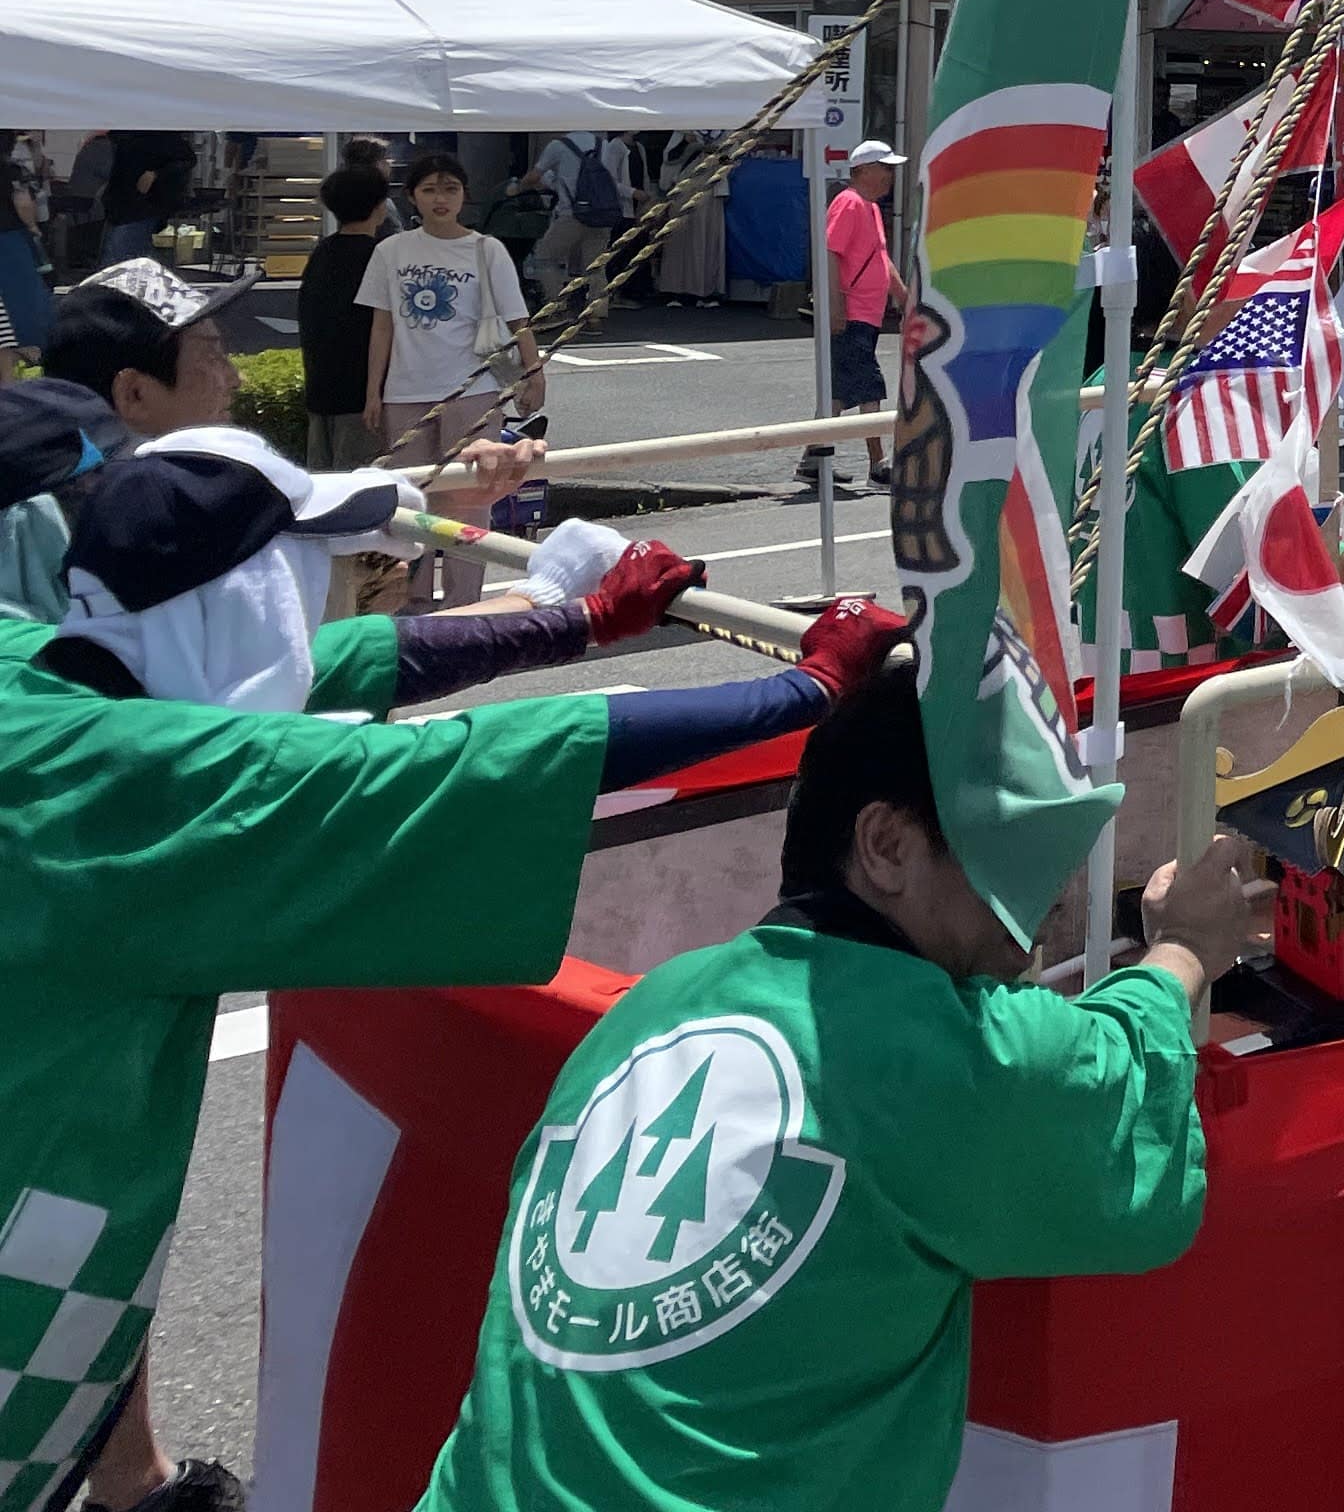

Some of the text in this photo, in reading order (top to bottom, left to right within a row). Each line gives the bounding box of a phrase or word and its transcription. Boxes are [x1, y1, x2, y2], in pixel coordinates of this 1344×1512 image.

[524, 1189, 794, 1345] きやまモール商店街
